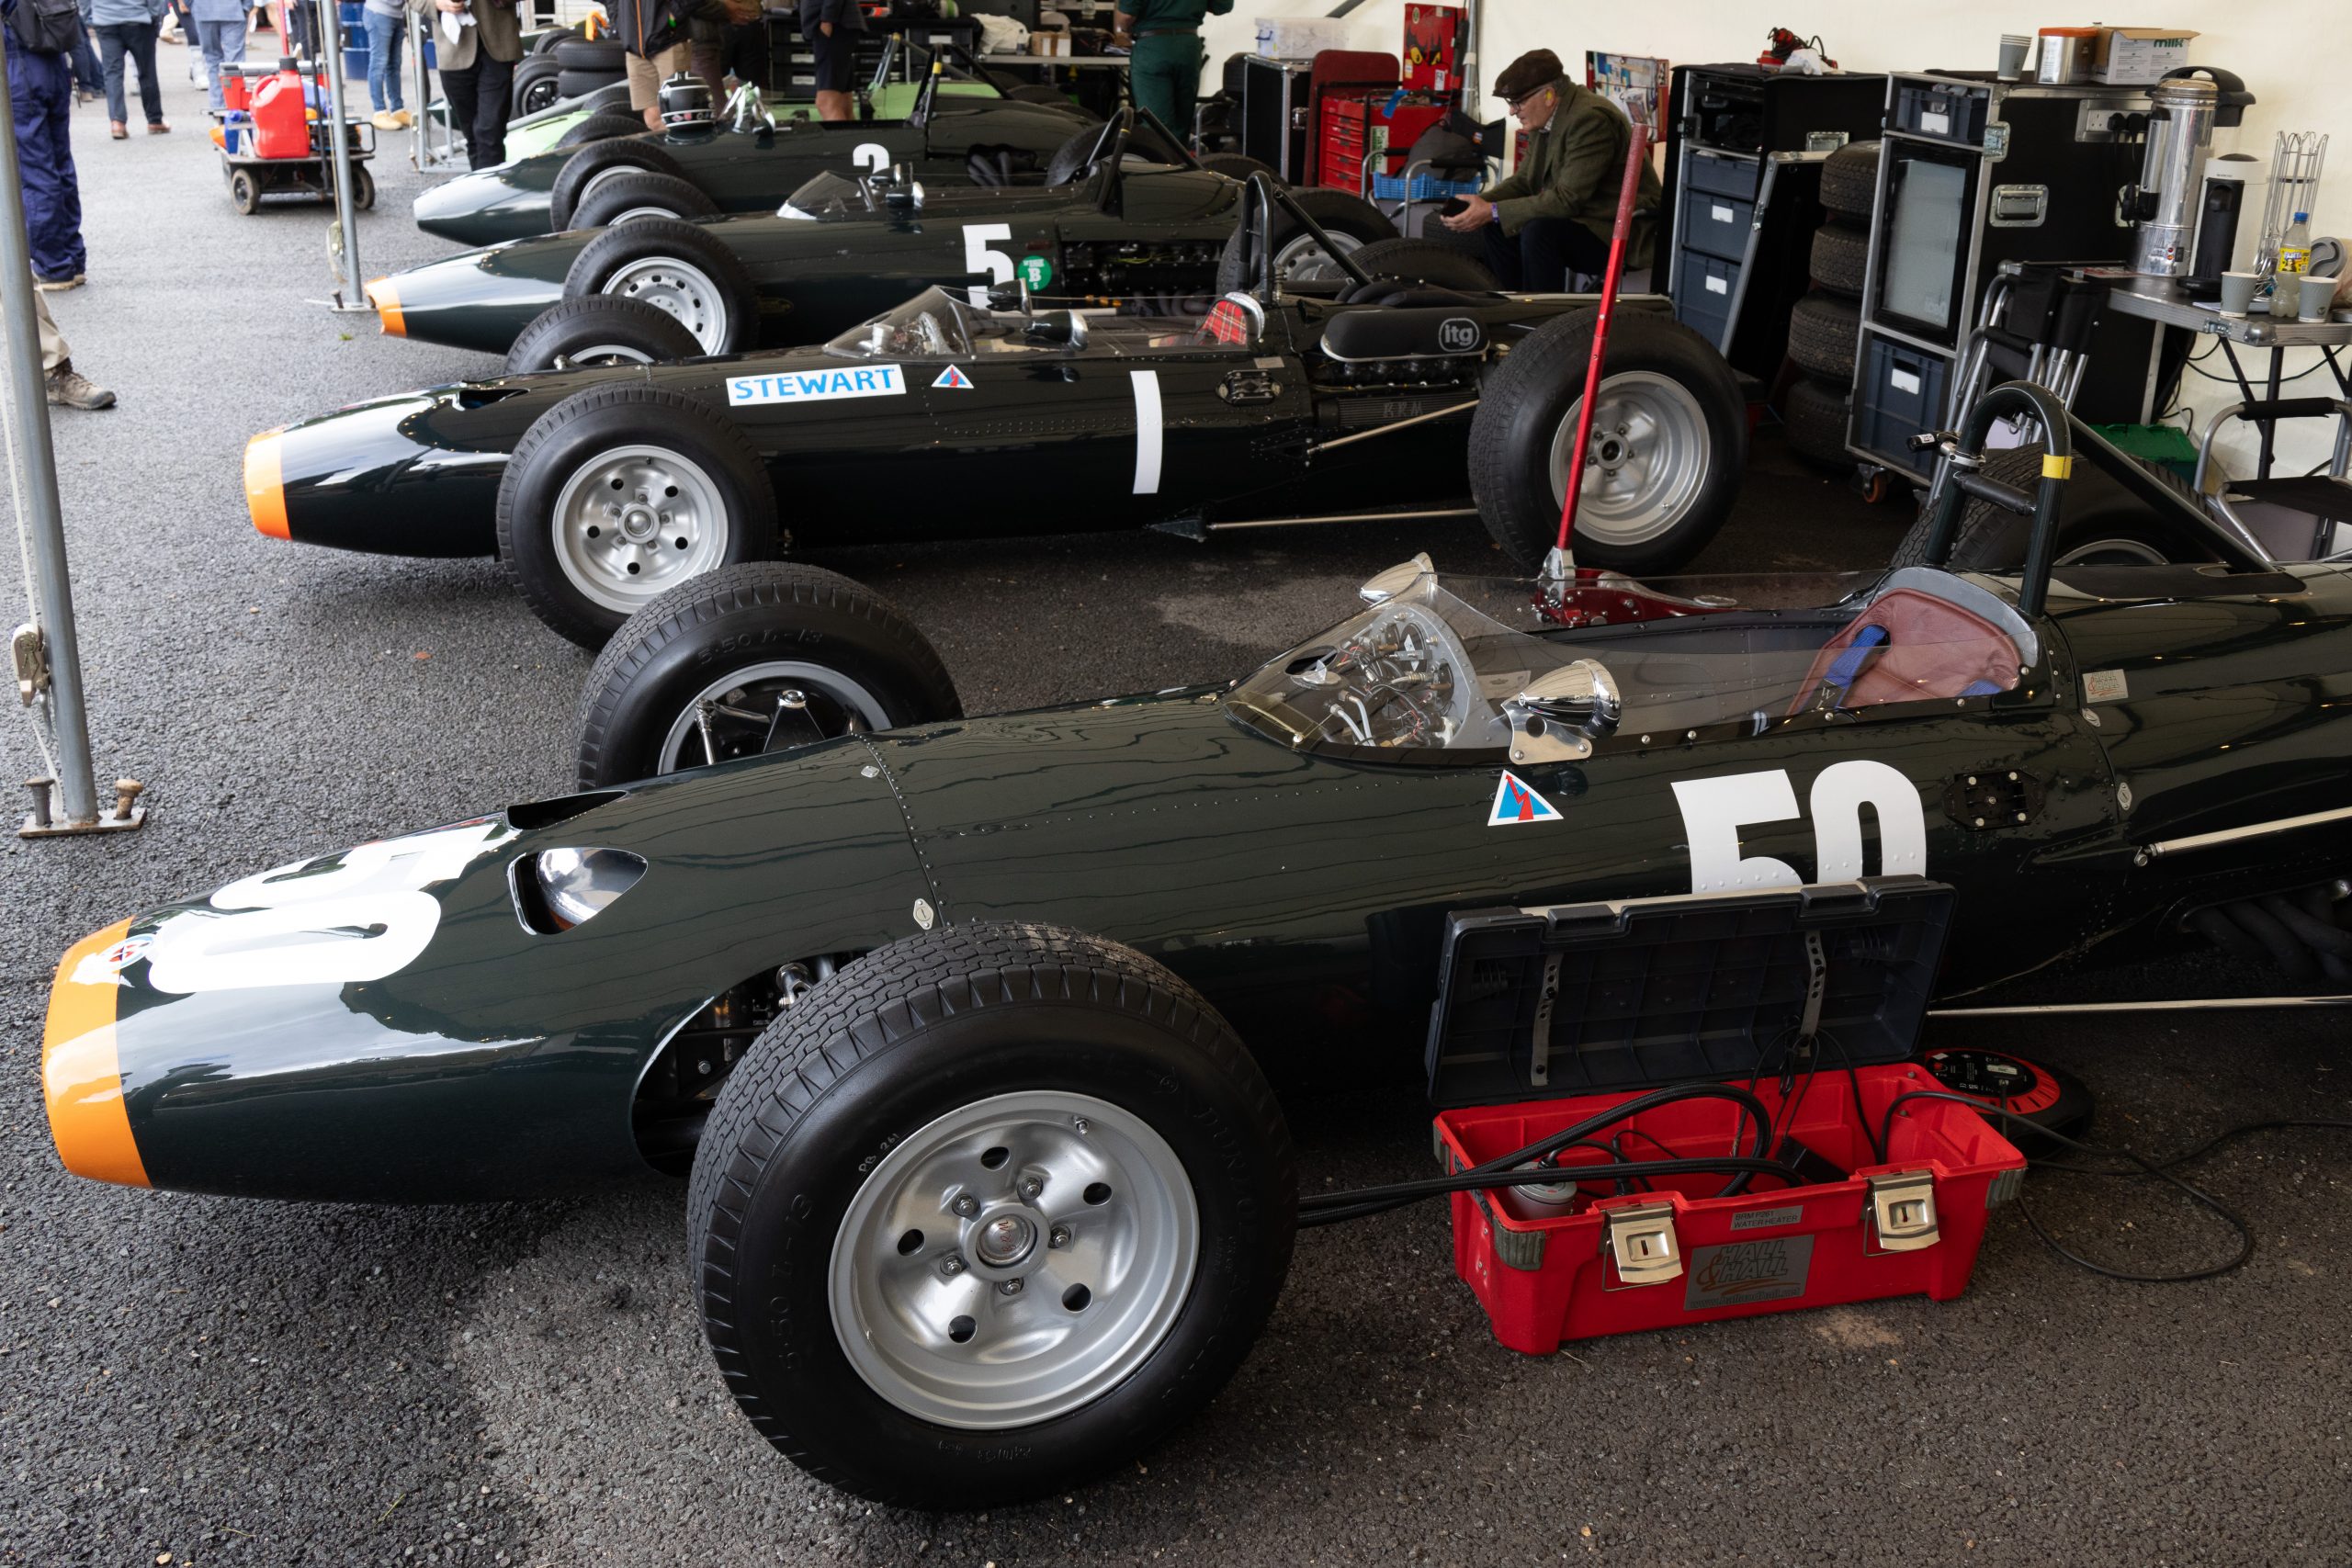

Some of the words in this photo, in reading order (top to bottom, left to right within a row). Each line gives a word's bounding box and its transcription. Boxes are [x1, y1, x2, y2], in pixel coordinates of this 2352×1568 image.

[1376, 130, 1385, 164] Maser
[962, 223, 1014, 310] 5
[1027, 267, 1042, 282] B
[1444, 324, 1474, 346] itg
[734, 369, 896, 400] STEWART
[1129, 370, 1163, 494] 1
[1734, 1219, 1764, 1228] WATER
[1765, 1215, 1798, 1224] HEATER
[1720, 1239, 1786, 1265] HALL
[1718, 1257, 1789, 1282] HALL
